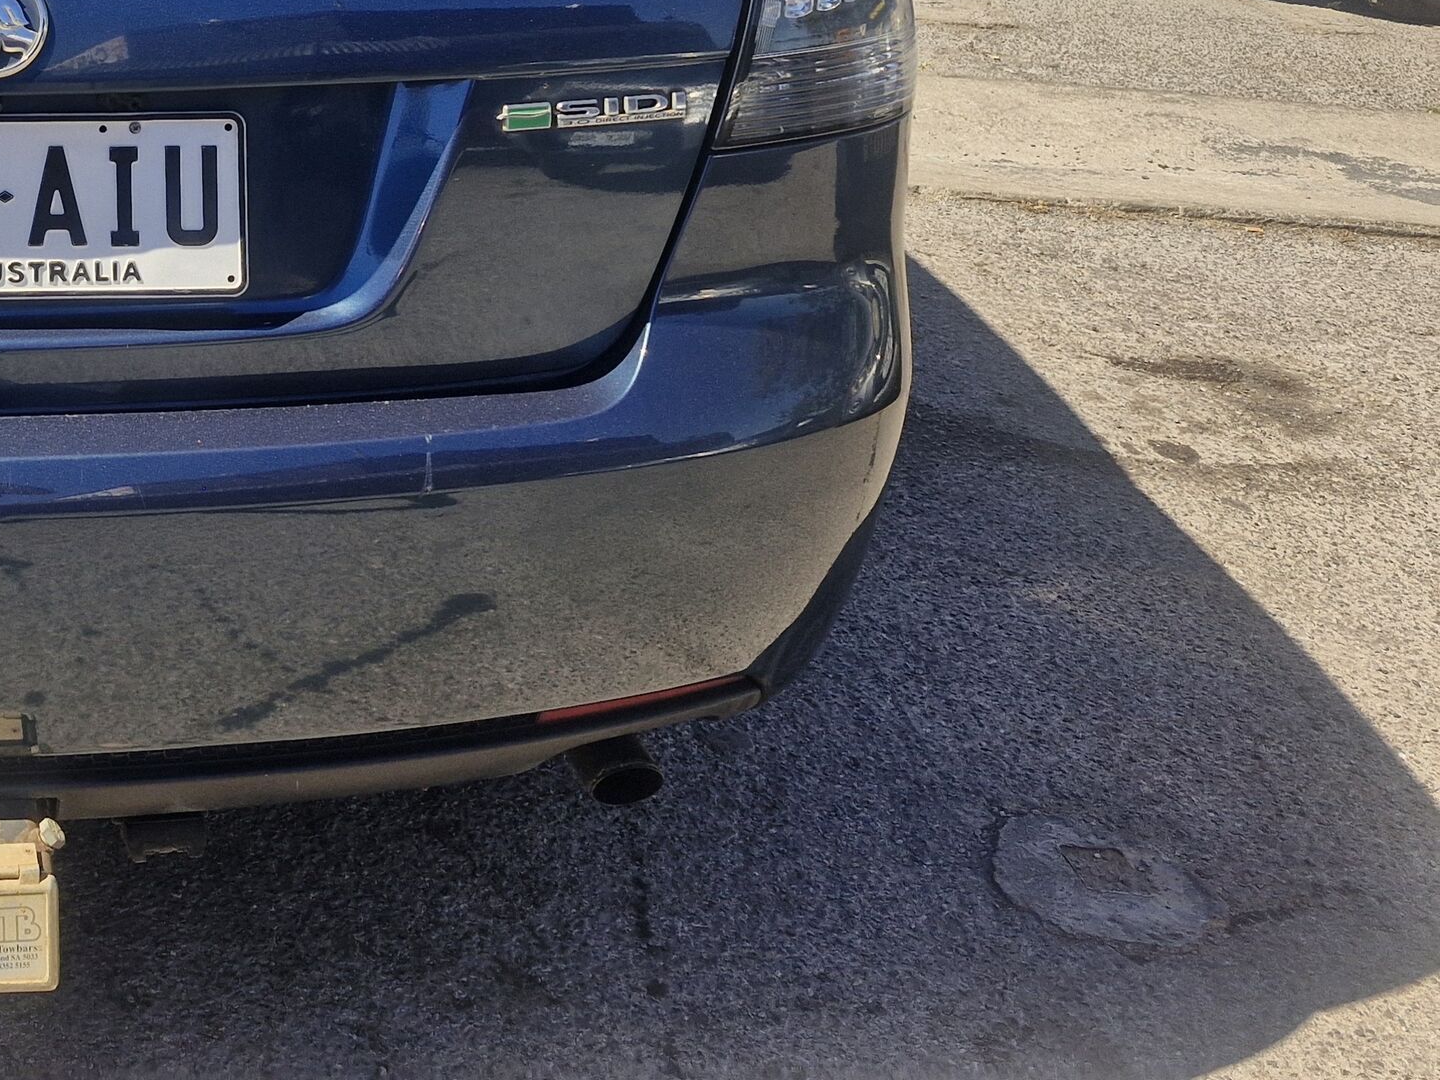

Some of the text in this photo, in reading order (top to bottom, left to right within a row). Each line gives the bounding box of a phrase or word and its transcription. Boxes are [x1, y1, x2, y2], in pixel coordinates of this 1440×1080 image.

[556, 92, 686, 118] SIDI
[596, 115, 631, 123] DIRECT
[634, 110, 684, 120] INJECTION
